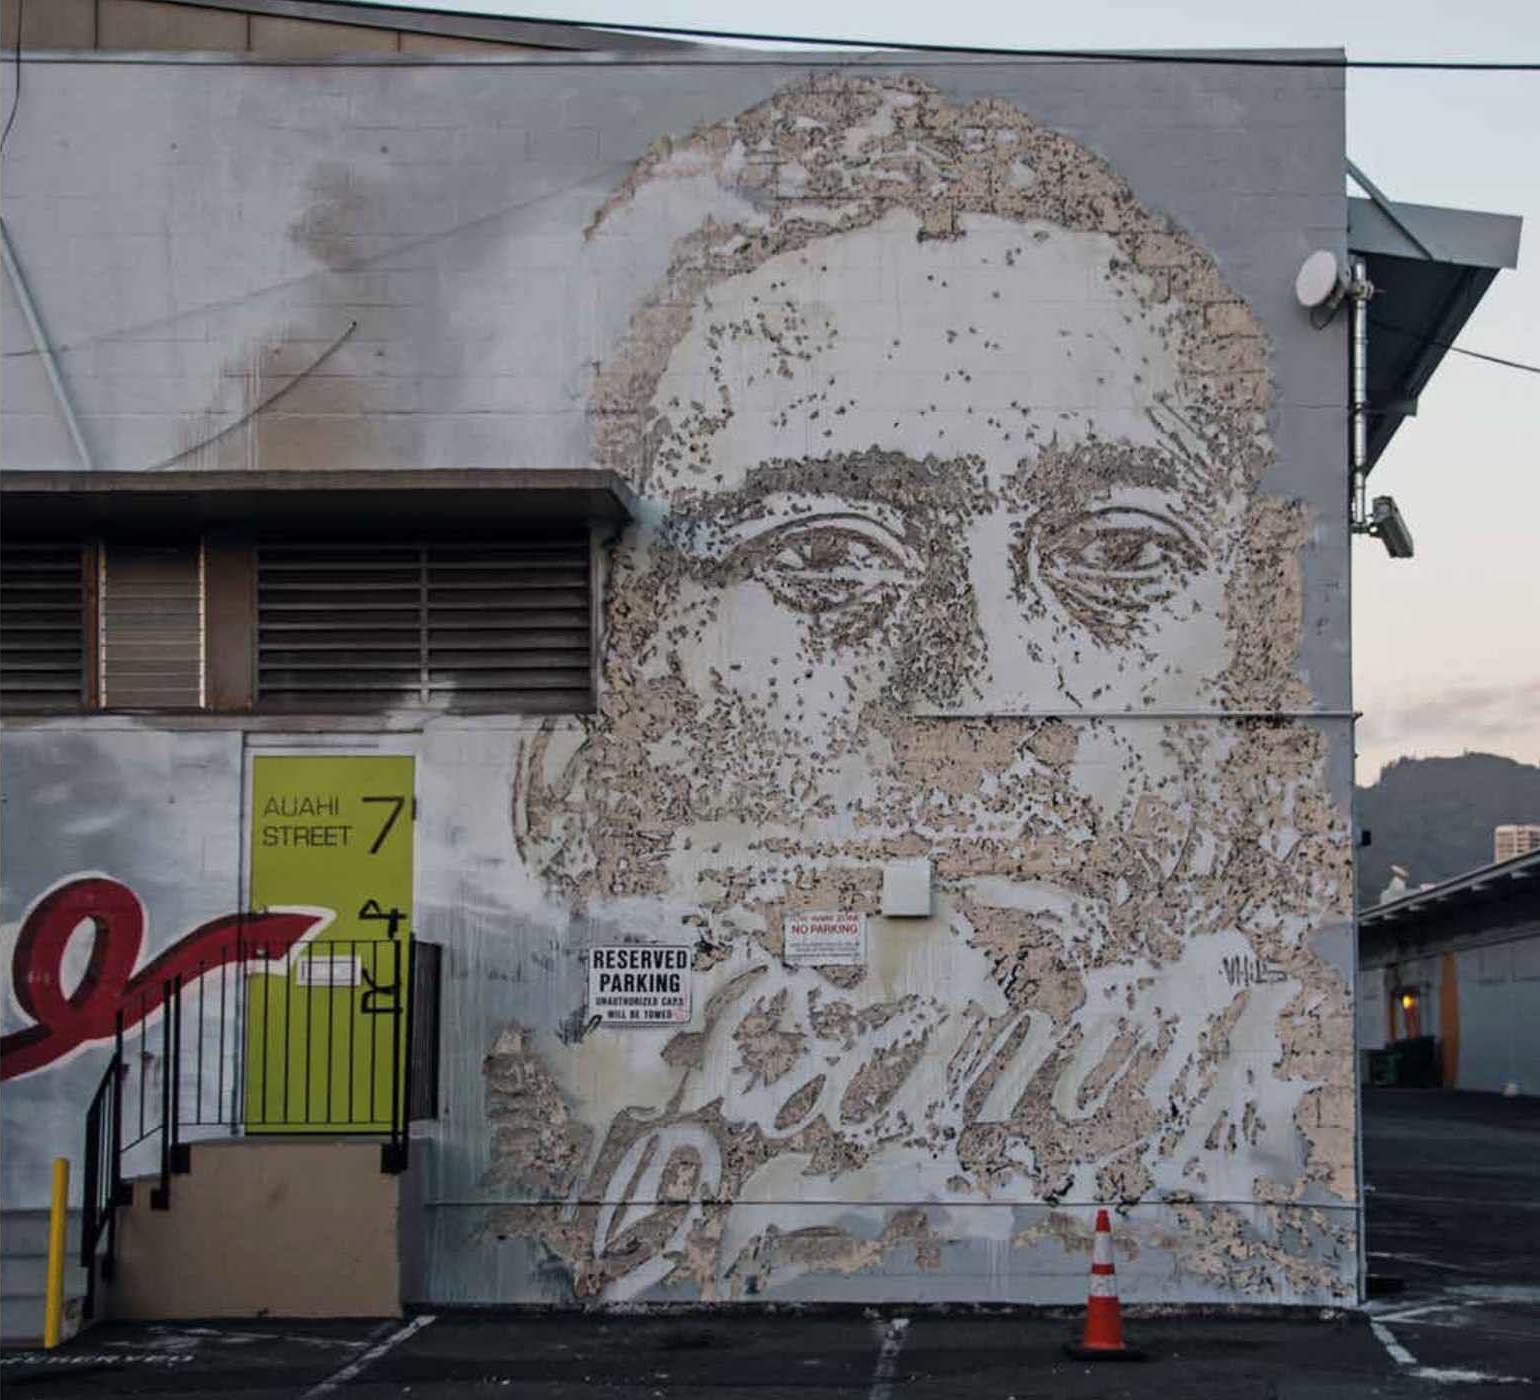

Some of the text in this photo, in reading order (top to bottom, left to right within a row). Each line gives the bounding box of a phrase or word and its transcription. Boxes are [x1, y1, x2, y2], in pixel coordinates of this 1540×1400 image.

[263, 795, 405, 854] AUAHI 7
[262, 825, 353, 847] STREET
[791, 923, 858, 935] NO PARKING
[593, 949, 688, 970] RESERVED
[600, 973, 681, 993] PARKING
[607, 1010, 627, 1019] WILL
[629, 1010, 640, 1019] BE
